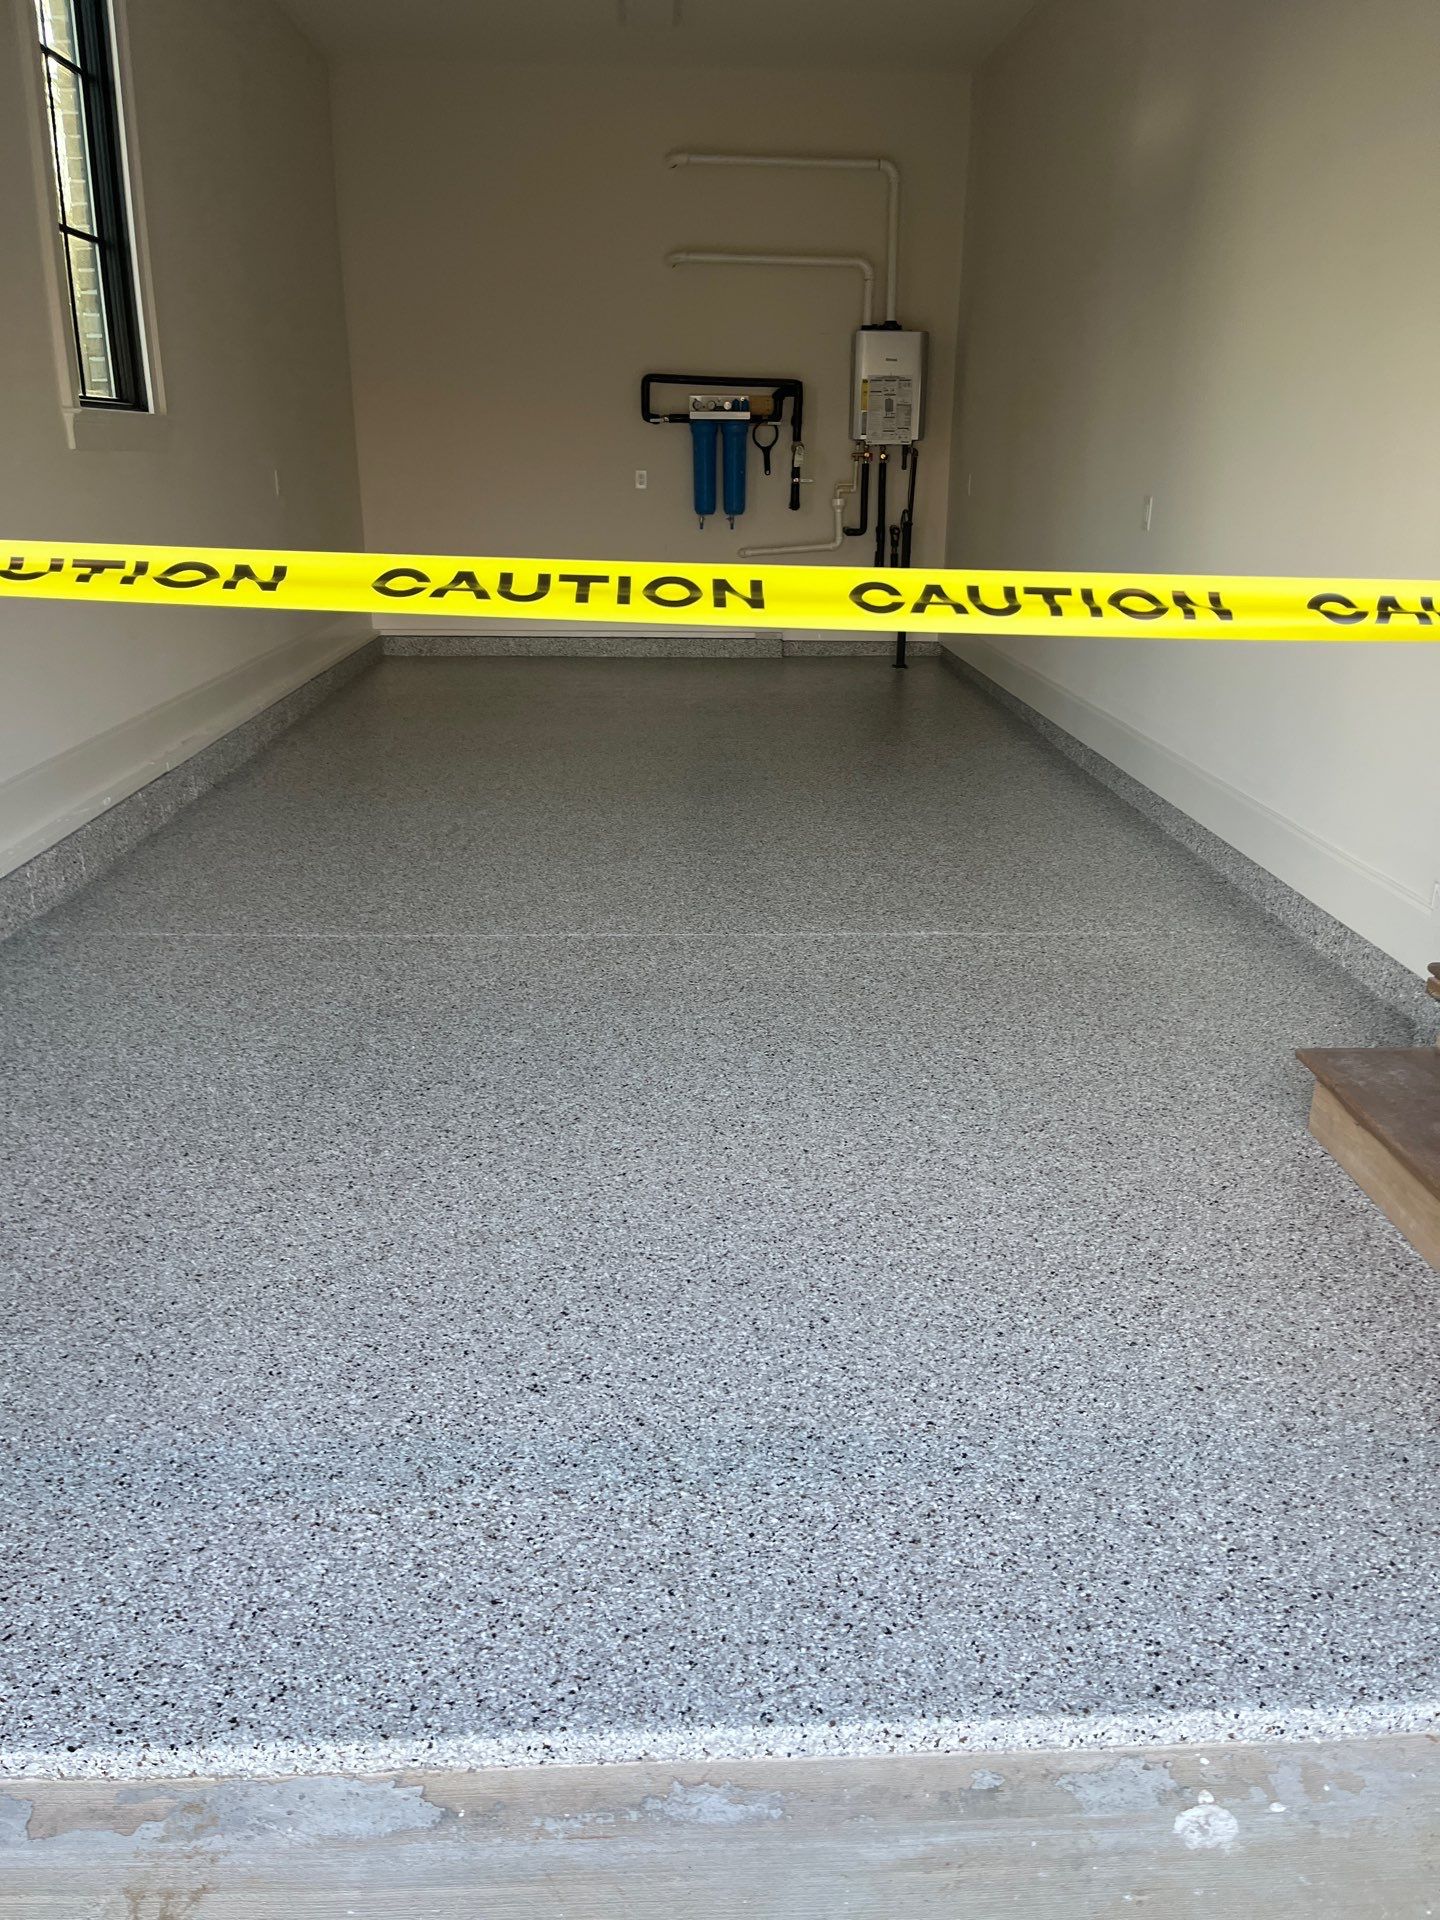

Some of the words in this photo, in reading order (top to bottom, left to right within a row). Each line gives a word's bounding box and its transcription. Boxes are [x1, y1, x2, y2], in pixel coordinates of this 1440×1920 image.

[0, 556, 288, 592] UTION
[372, 567, 765, 610] CAUTION
[850, 581, 1233, 621] CAUTION
